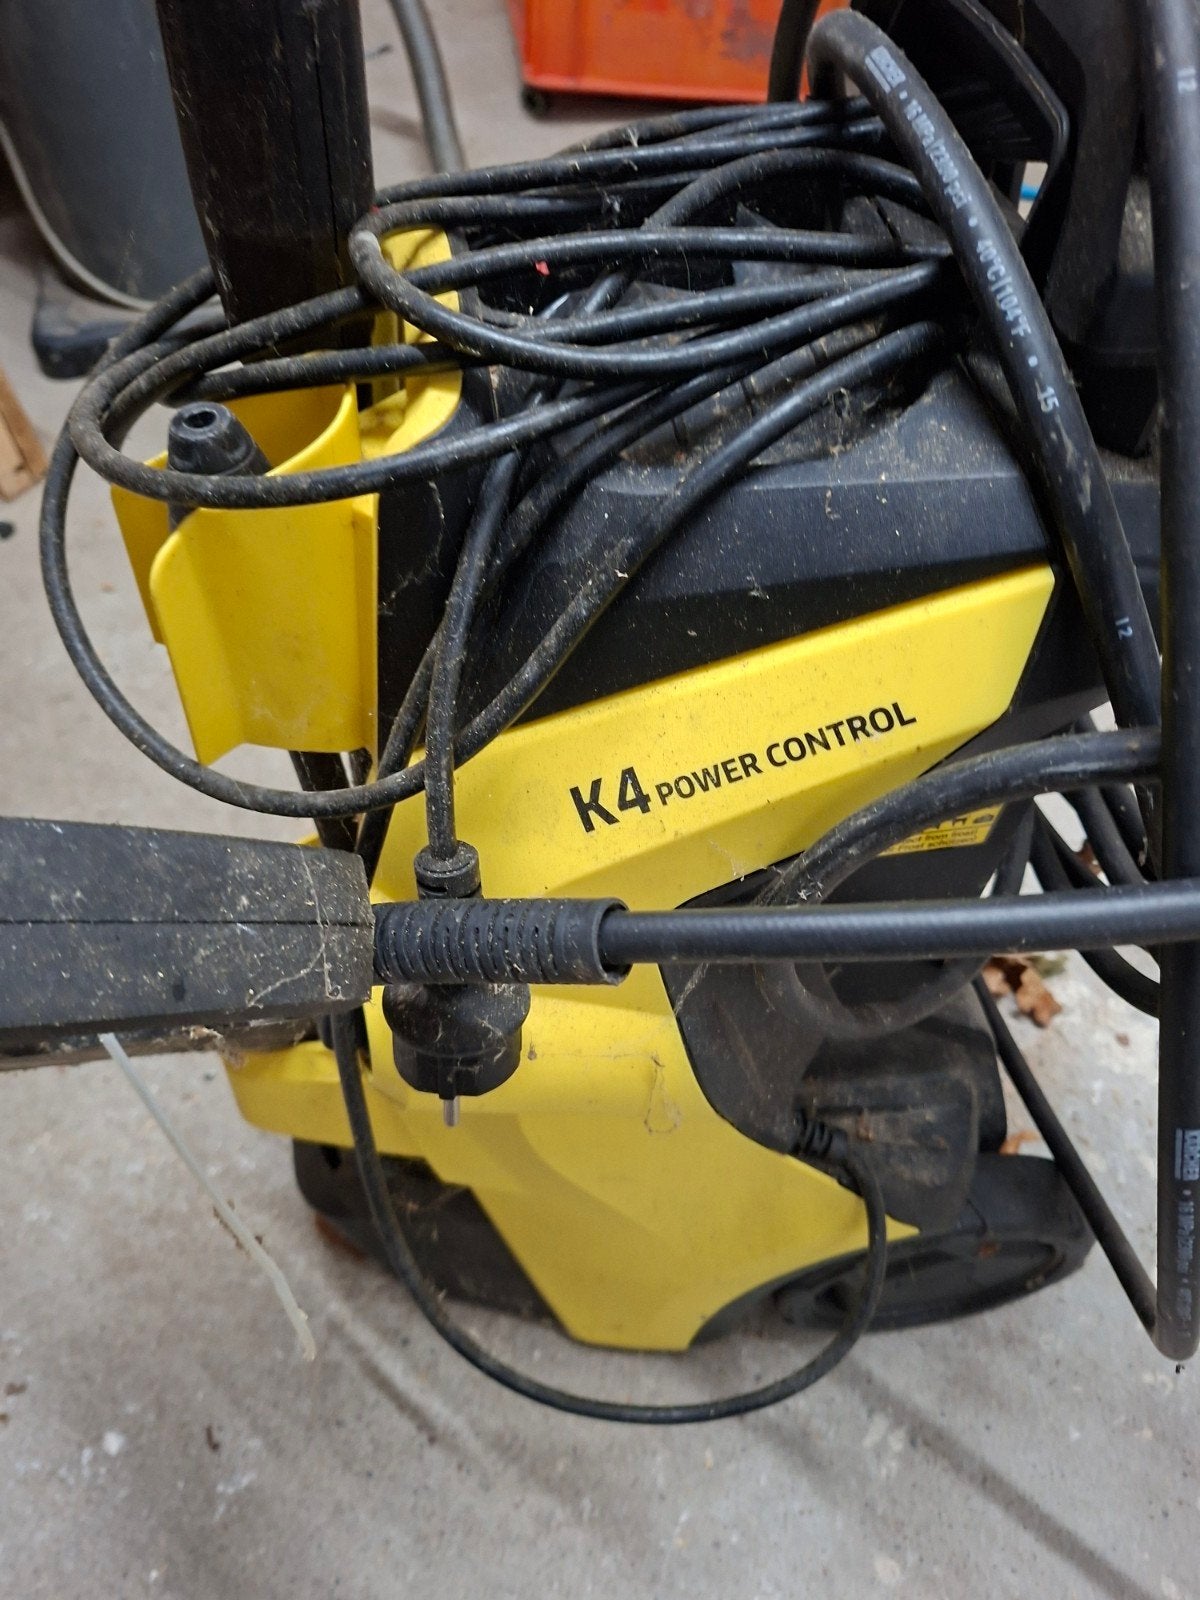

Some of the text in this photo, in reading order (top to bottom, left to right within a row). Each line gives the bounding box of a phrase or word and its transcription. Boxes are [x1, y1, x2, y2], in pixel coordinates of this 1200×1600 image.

[1115, 616, 1133, 641] 12
[569, 702, 917, 833] K4 POWER CONTROL
